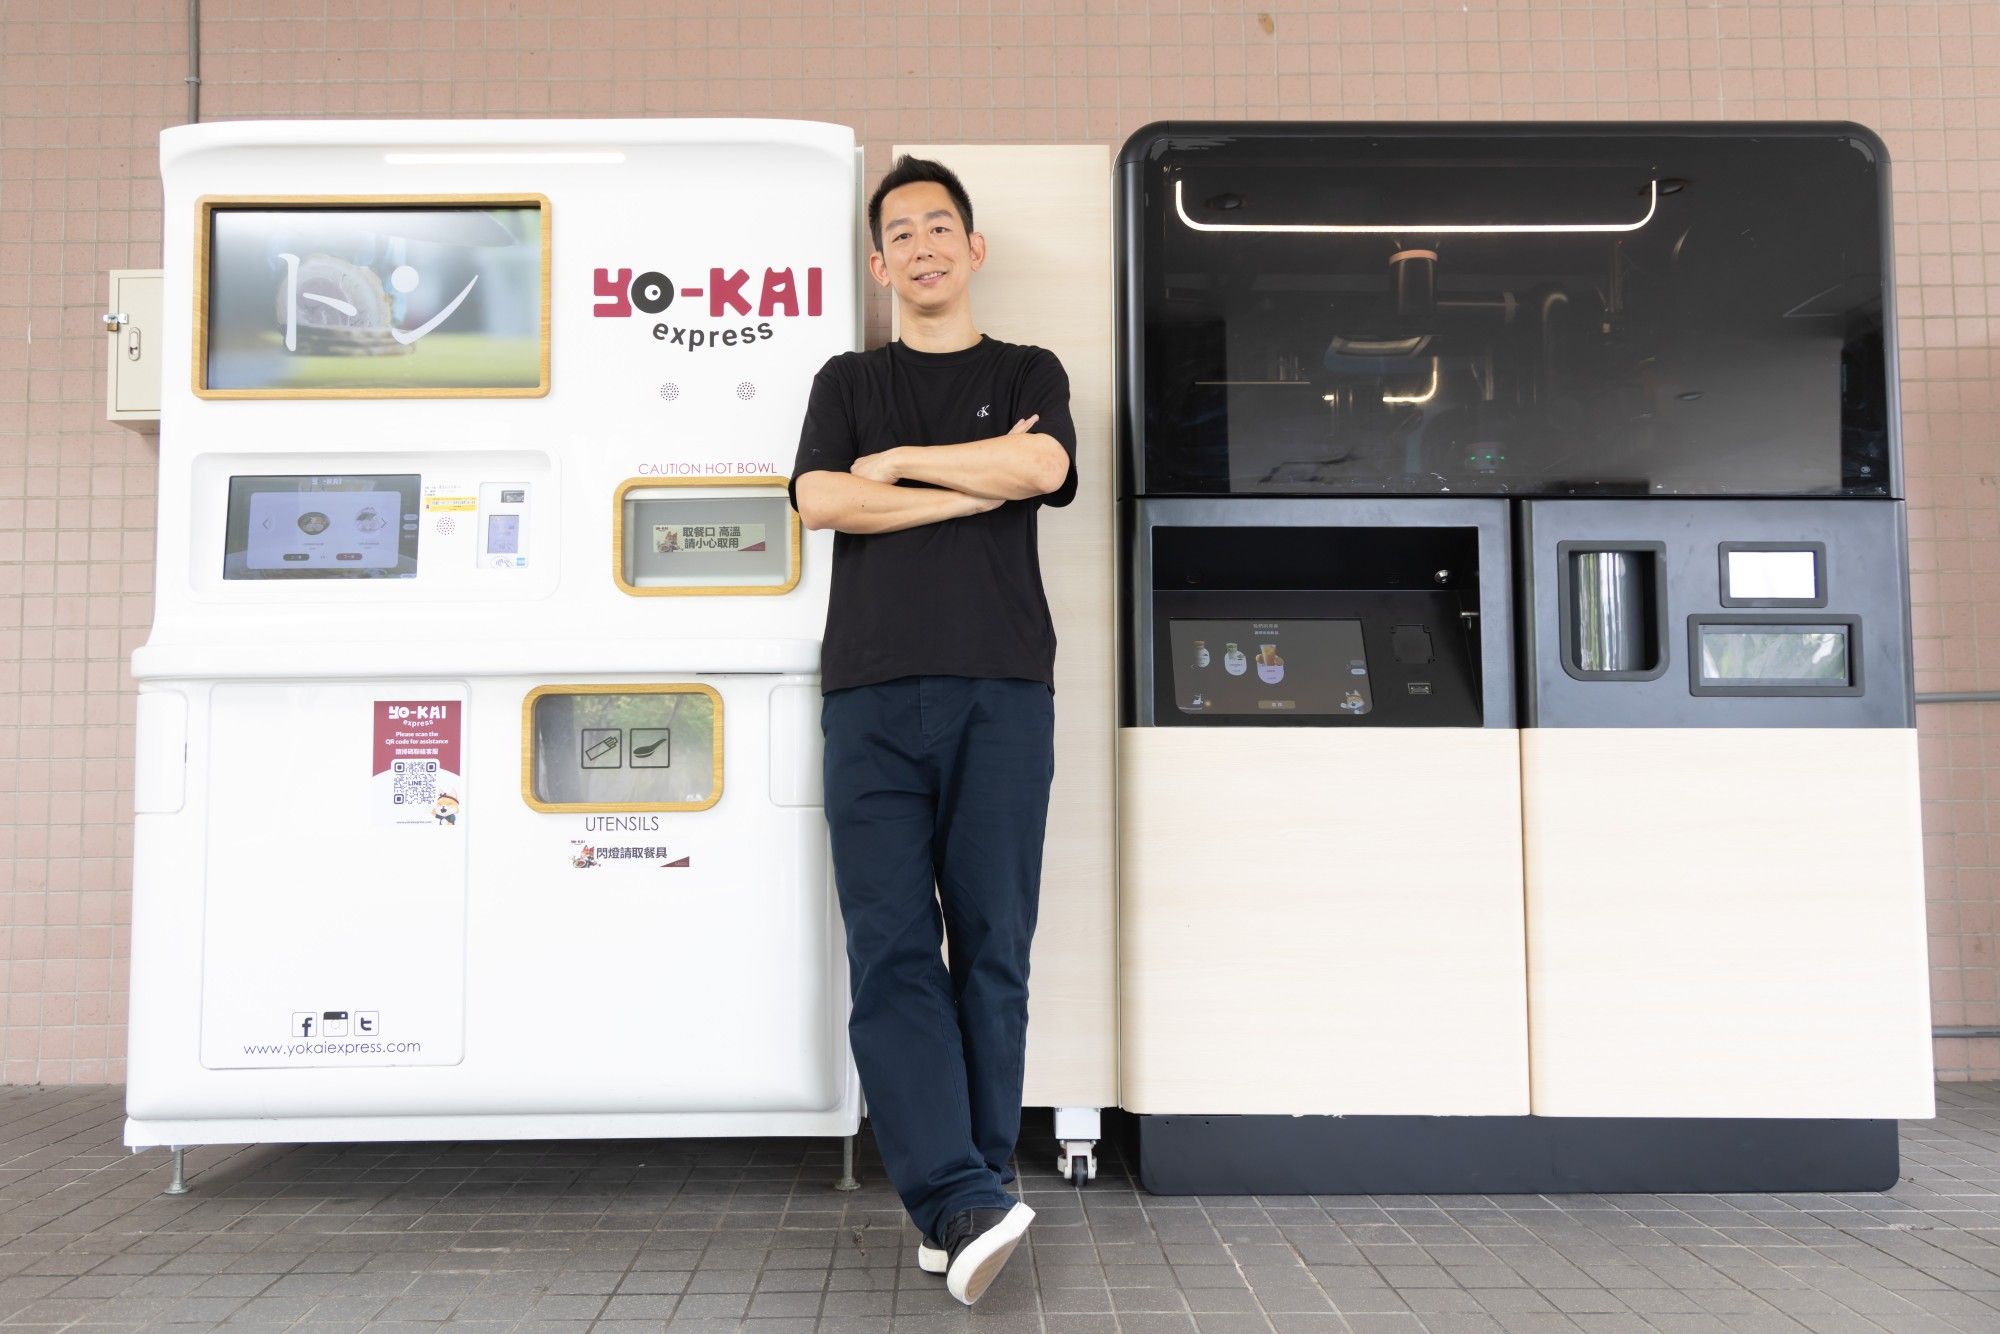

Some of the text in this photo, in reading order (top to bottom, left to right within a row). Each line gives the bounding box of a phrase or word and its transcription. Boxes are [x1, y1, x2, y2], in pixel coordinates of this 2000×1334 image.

[593, 266, 823, 318] YO-KAI
[652, 322, 774, 352] express
[638, 462, 778, 475] CAUTION HOT BOWL
[682, 526, 716, 538] 取餐口
[719, 525, 741, 538] 高溫
[684, 537, 739, 549] 請小心取用
[388, 705, 447, 720] YO-KAI
[403, 719, 434, 728] express
[585, 816, 660, 831] UTENSILS
[596, 847, 668, 859] 閃燈請取餐具
[243, 1041, 421, 1057] www.yokaiexpress.com
